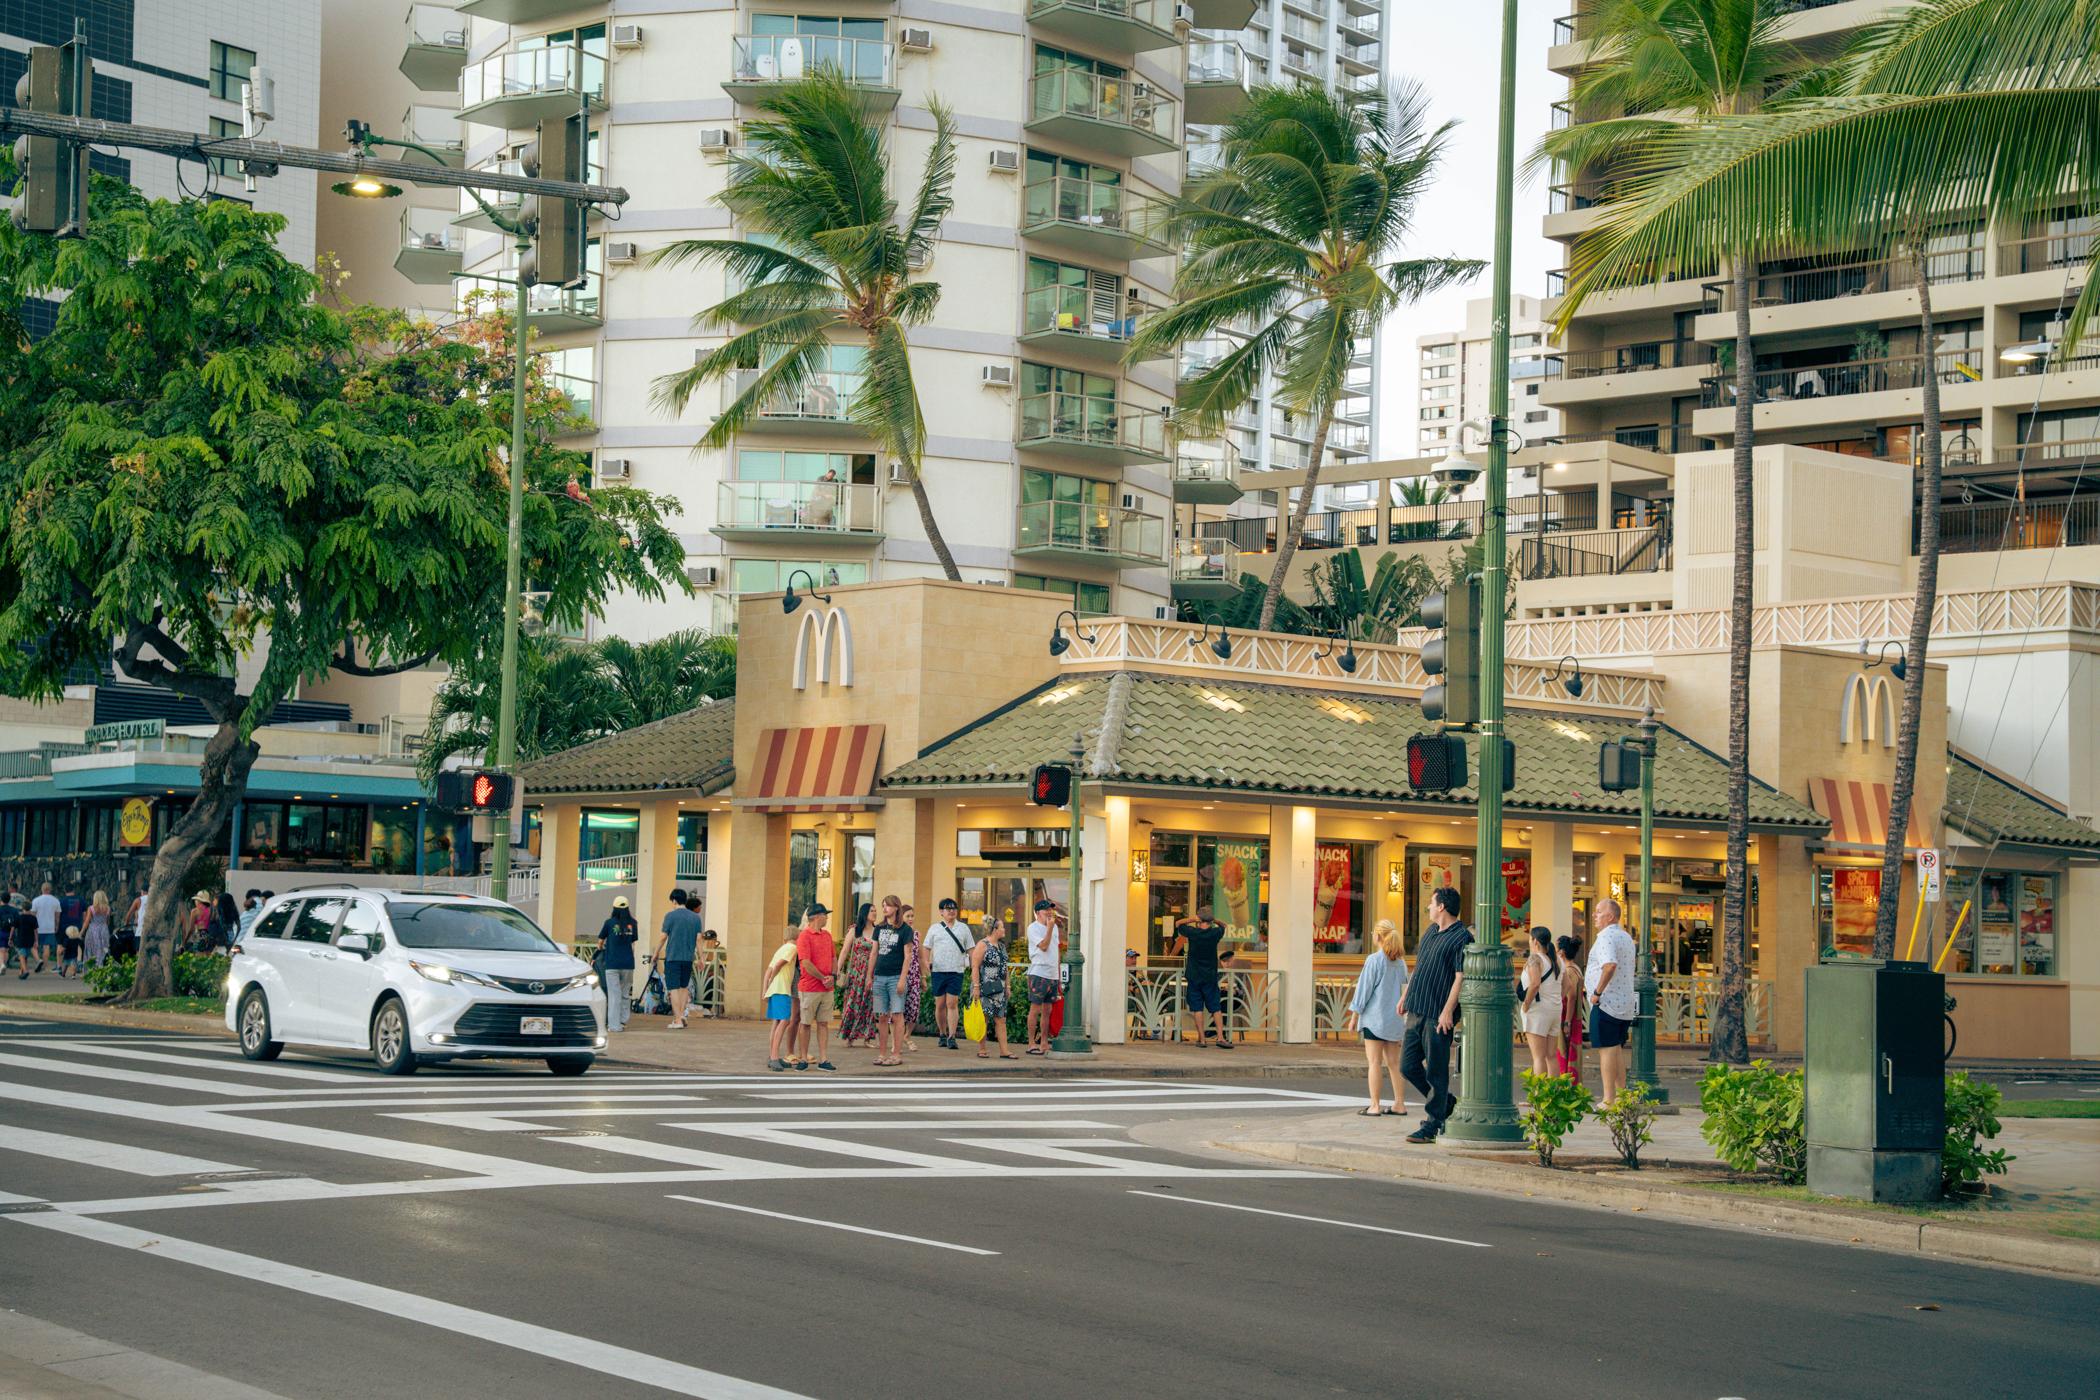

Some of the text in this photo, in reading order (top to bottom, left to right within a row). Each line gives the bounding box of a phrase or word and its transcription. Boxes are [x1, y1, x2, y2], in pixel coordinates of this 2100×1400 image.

[119, 722, 156, 739] HOTEL
[1217, 844, 1258, 860] SNACK
[1316, 847, 1348, 862] NACK
[1848, 870, 1868, 886] SPICY
